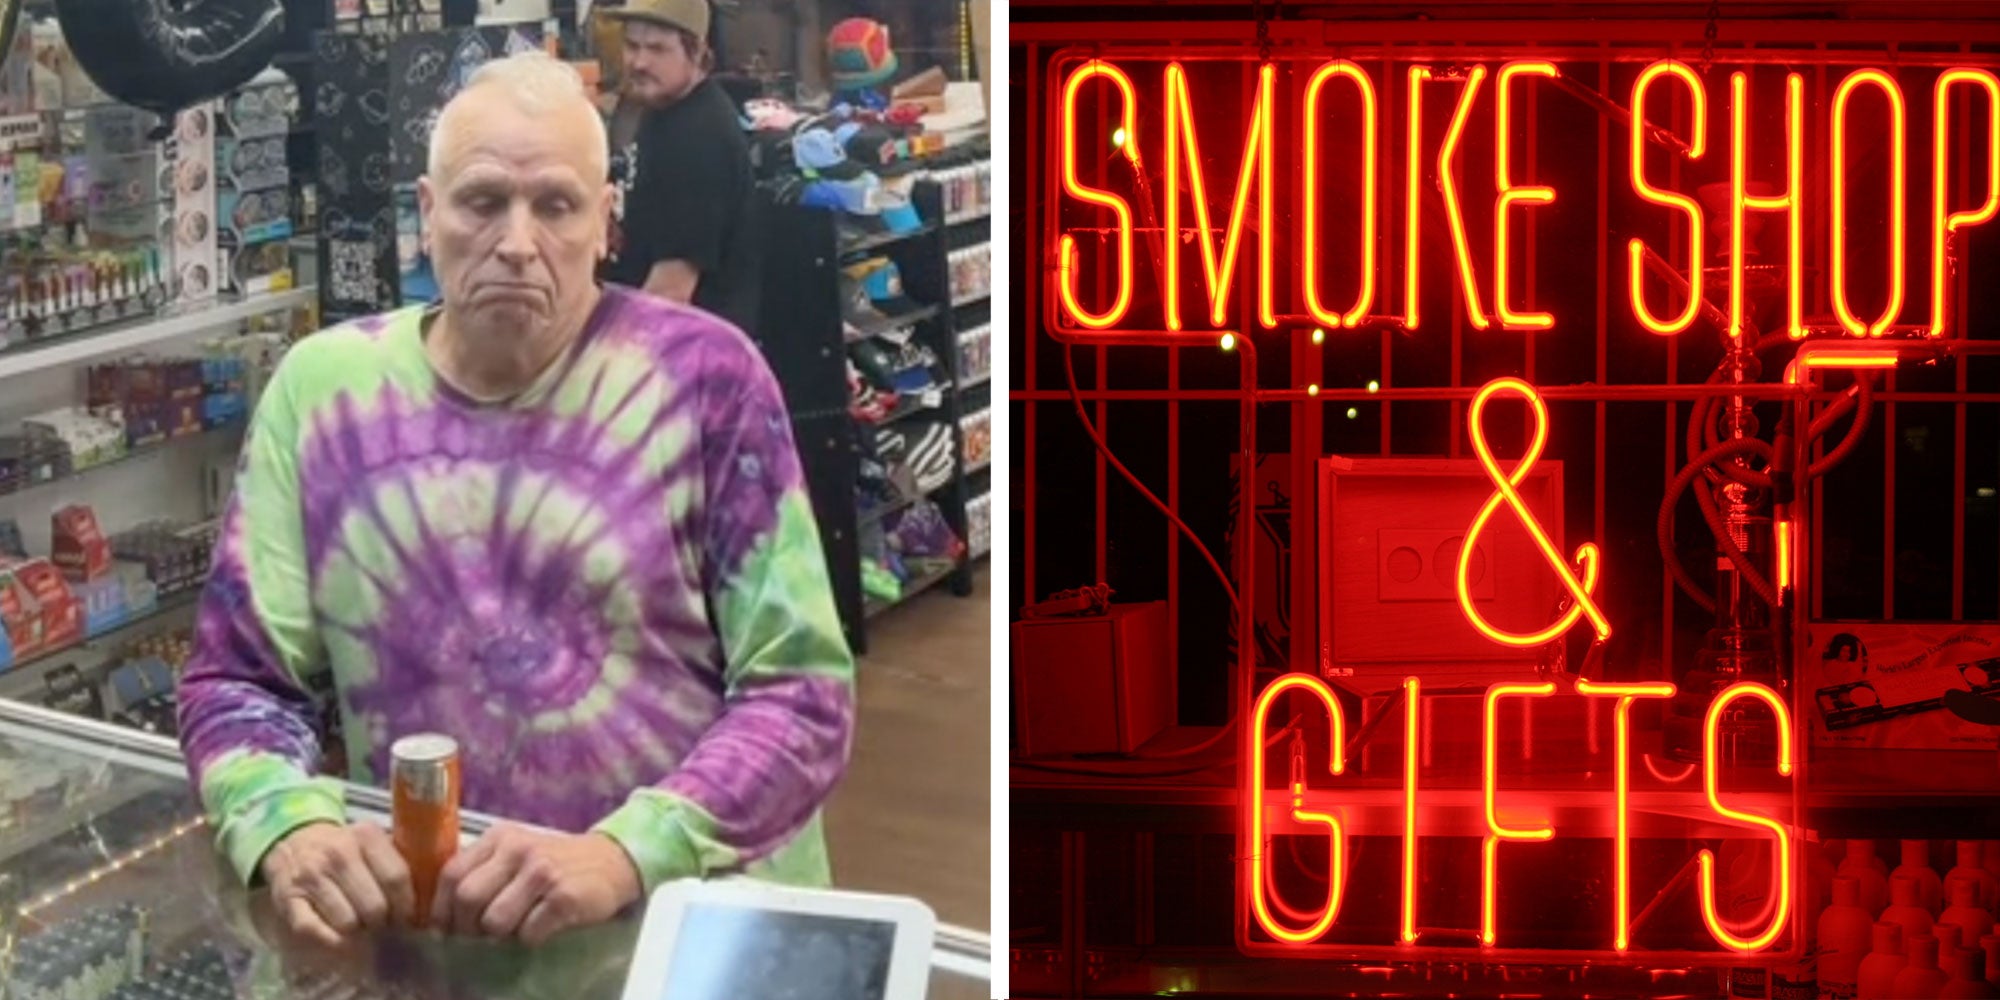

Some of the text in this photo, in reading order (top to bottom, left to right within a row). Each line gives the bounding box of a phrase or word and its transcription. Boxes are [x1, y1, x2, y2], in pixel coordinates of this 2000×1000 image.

[1057, 58, 2000, 341] SMOKE SHOP
[1454, 376, 1612, 647] &
[1250, 674, 1795, 953] GIFTS
